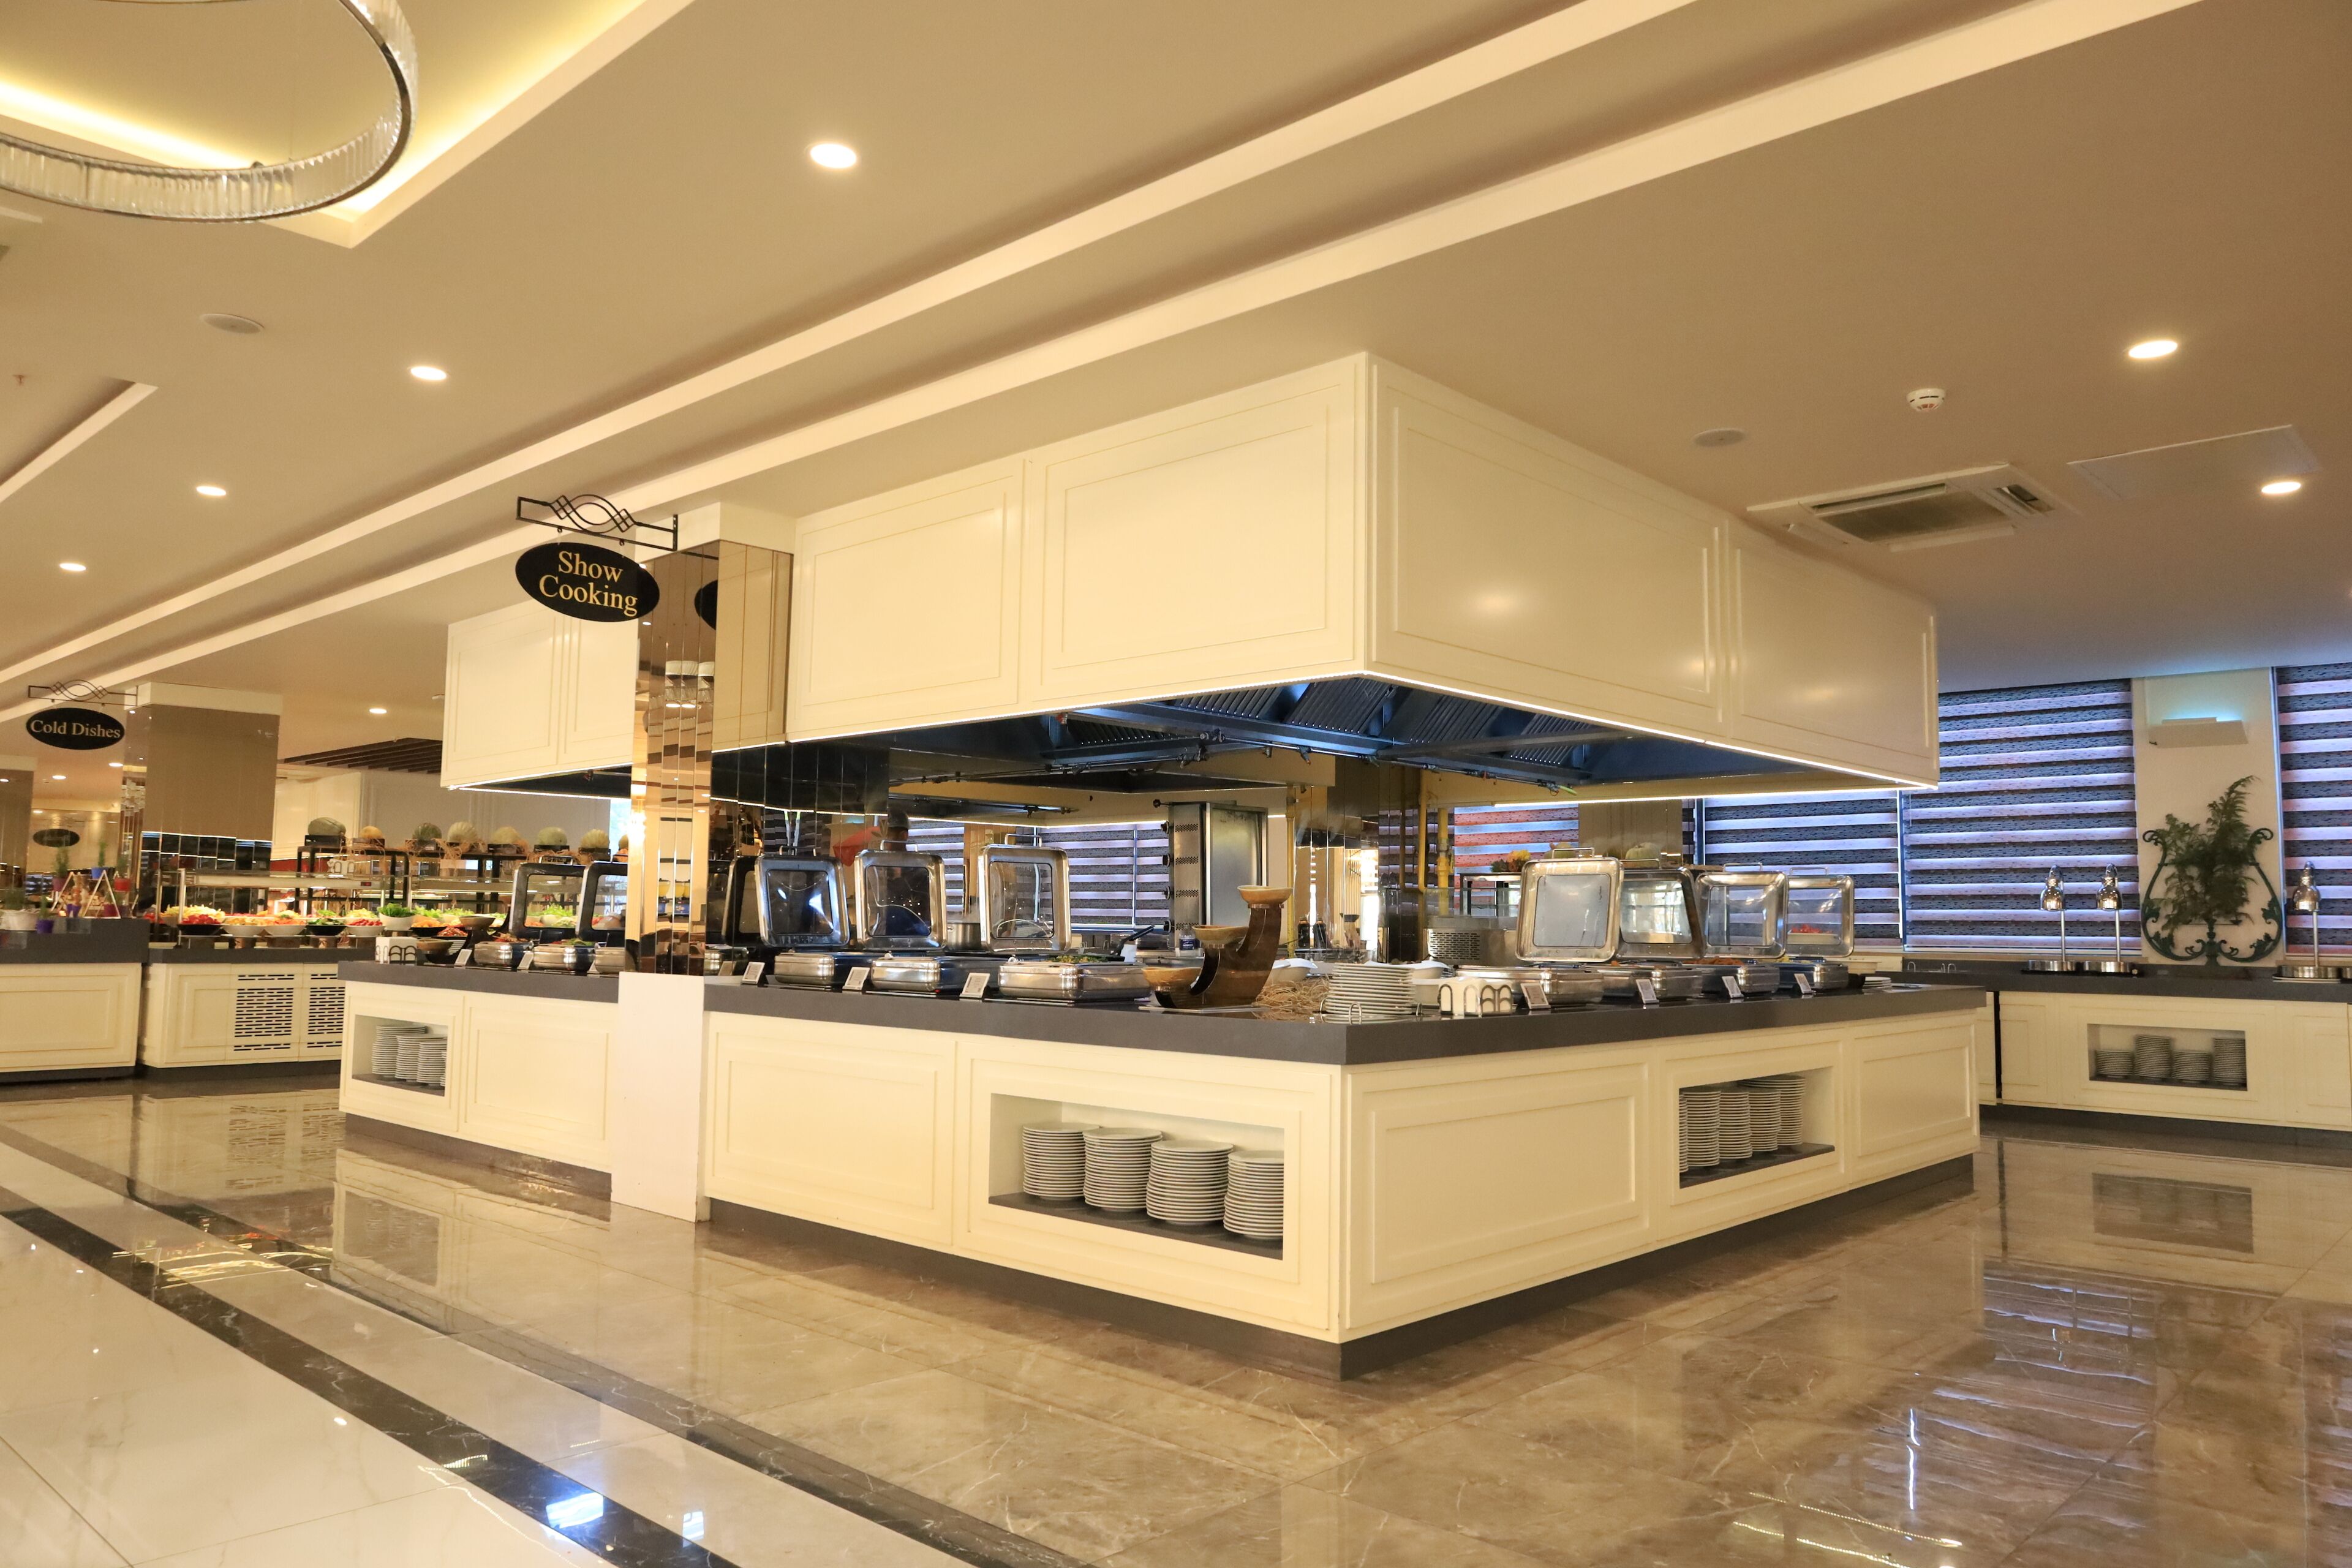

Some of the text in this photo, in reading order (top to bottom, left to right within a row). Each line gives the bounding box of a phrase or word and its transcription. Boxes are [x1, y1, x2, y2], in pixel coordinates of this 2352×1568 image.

[559, 551, 623, 582] Show
[539, 575, 638, 617] Cooking
[31, 720, 121, 738] Cold Dishes
